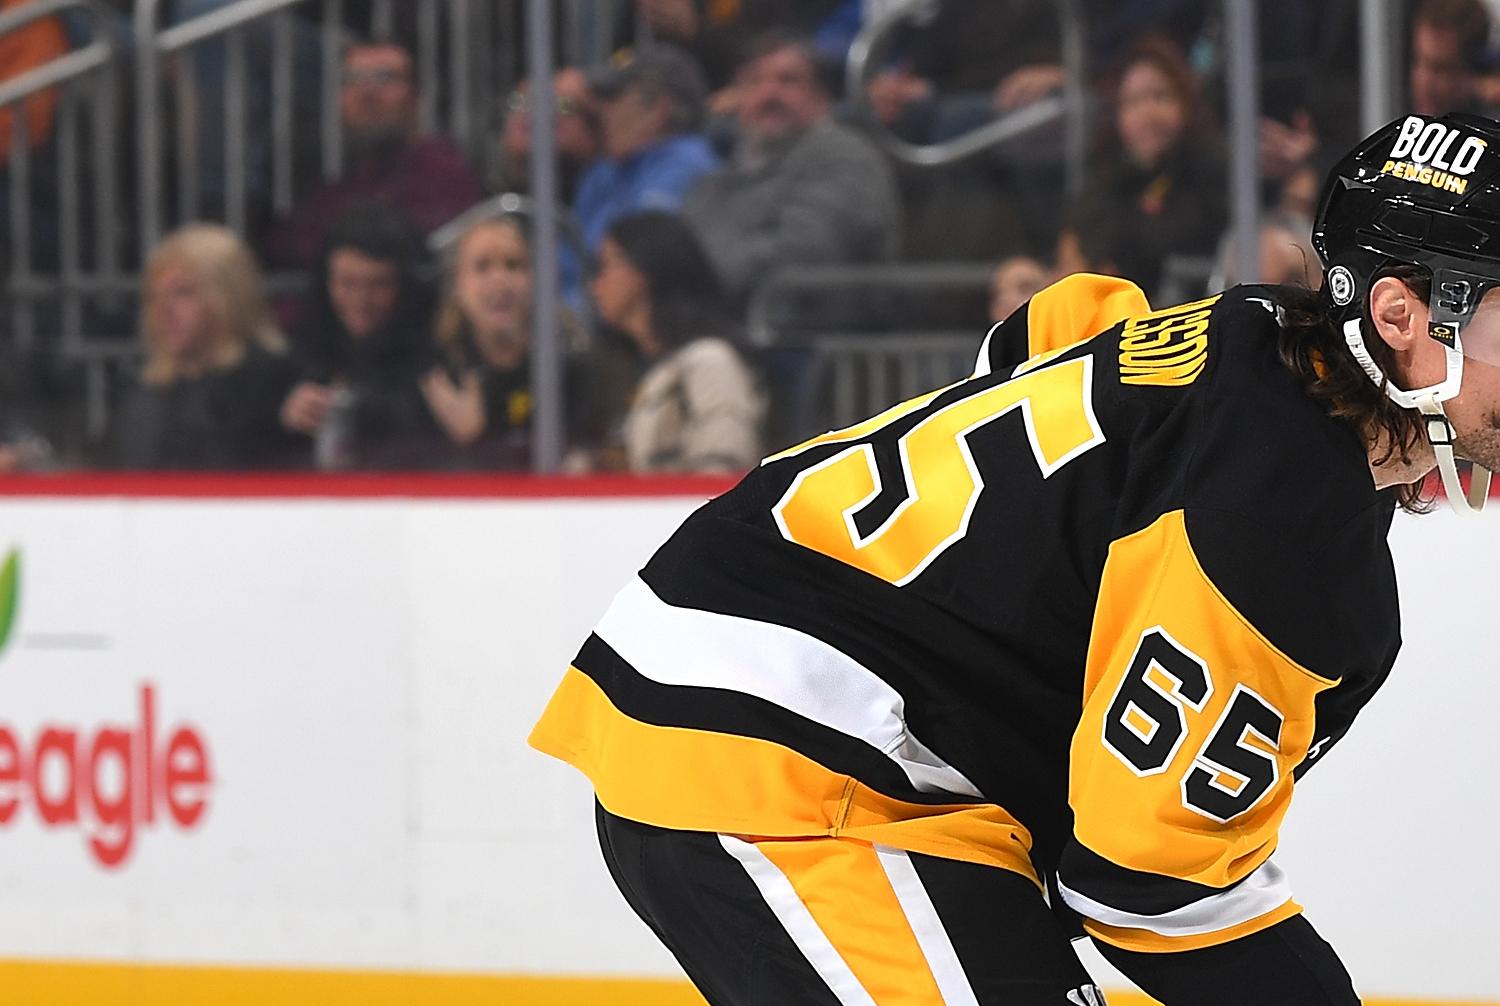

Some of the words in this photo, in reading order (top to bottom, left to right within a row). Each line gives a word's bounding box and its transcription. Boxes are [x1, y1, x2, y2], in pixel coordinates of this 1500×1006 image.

[1380, 160, 1468, 195] PENGUIN
[1389, 115, 1488, 176] BOLD
[1118, 294, 1223, 386] LSSON
[761, 340, 1105, 587] 5
[1101, 625, 1284, 823] 65
